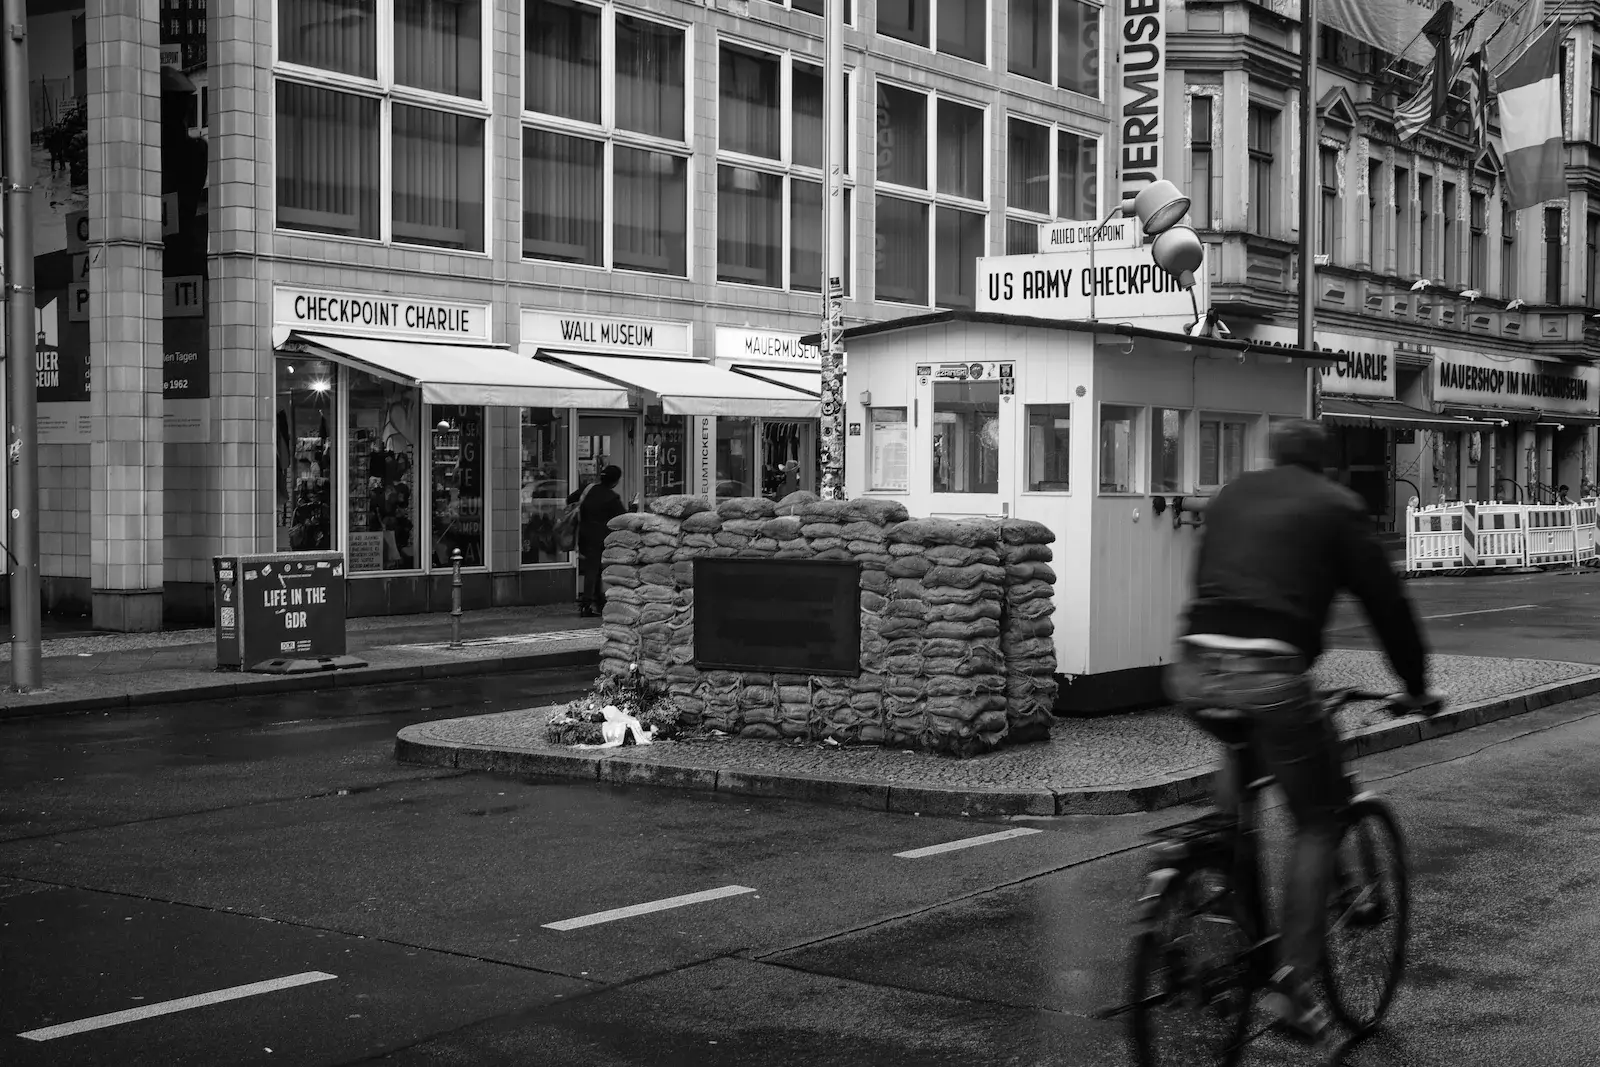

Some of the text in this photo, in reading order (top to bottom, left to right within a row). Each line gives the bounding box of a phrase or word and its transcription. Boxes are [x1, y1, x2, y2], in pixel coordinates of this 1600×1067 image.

[1050, 224, 1125, 245] ALLIED CHECKPOINT
[174, 281, 198, 306] IT!
[1023, 268, 1073, 300] ARMY
[294, 295, 469, 332] CHECKPOINT CHARLIE
[560, 319, 653, 347] WALL MUSEUM
[175, 351, 198, 363] Tagen
[745, 336, 821, 360] MAUERMUSEU
[36, 351, 59, 371] UER
[1336, 349, 1388, 382] CHARLIE
[169, 379, 189, 389] 1962
[1440, 361, 1588, 401] MAUERSHOP IM MAUERMUSEUM
[701, 417, 709, 504] SEUMTICKETS
[263, 586, 327, 607] LIFE IN THE
[285, 611, 307, 629] GDR
